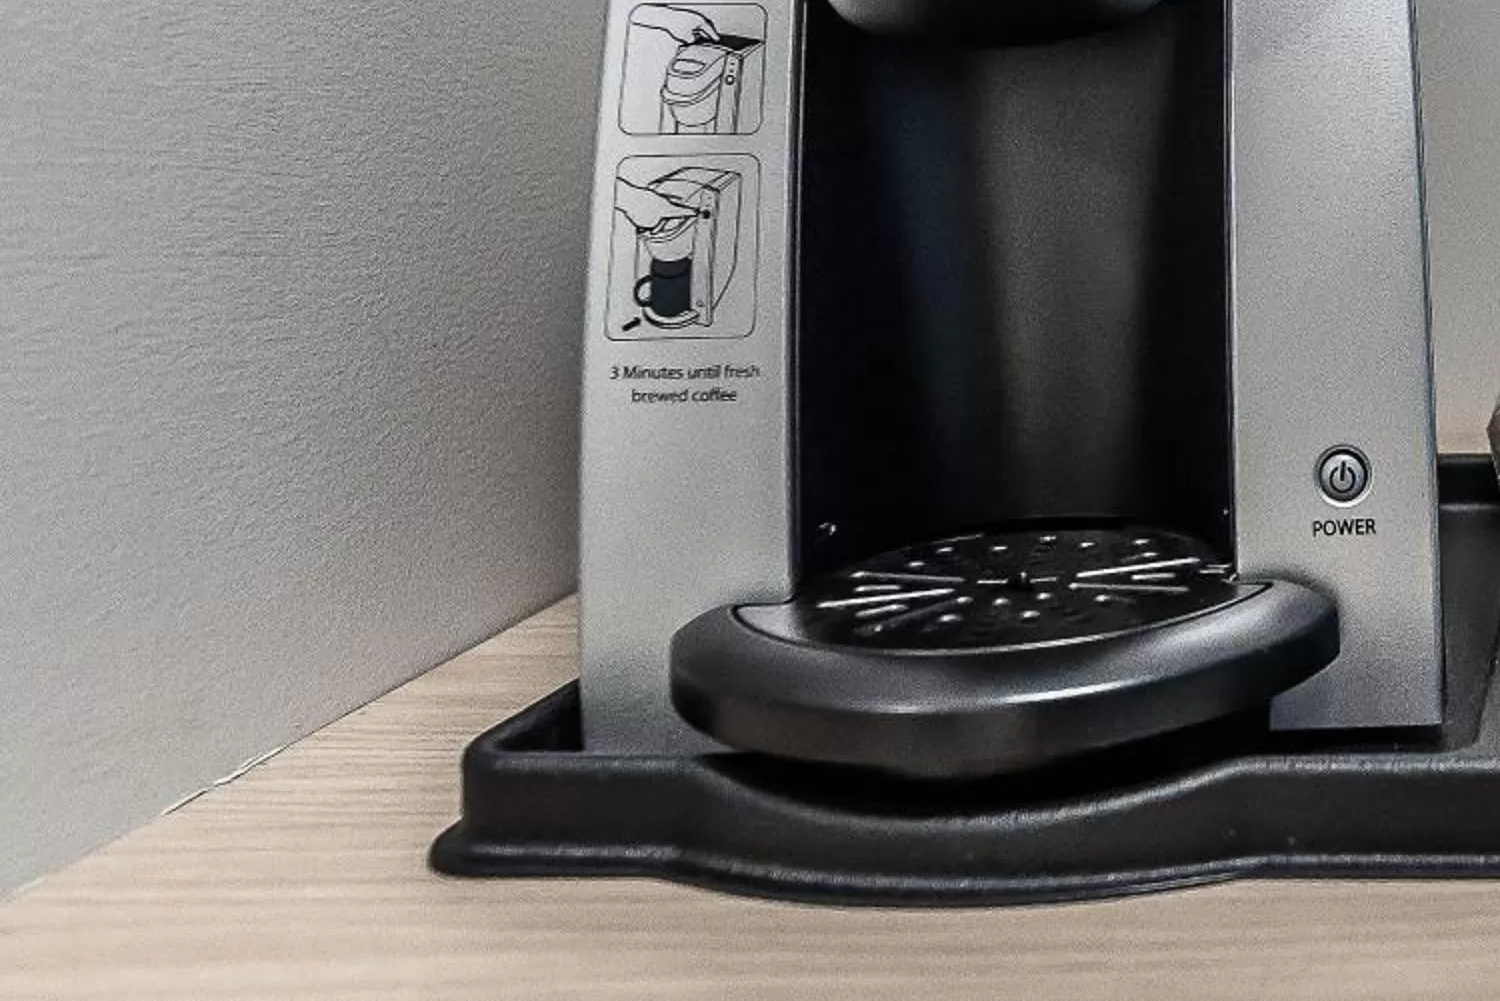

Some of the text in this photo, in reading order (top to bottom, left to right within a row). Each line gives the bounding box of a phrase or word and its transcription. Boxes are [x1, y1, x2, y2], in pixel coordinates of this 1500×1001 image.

[609, 364, 761, 380] 3 Minutes until fresh
[631, 387, 737, 403] brewed coffee
[1311, 518, 1377, 538] POWER
